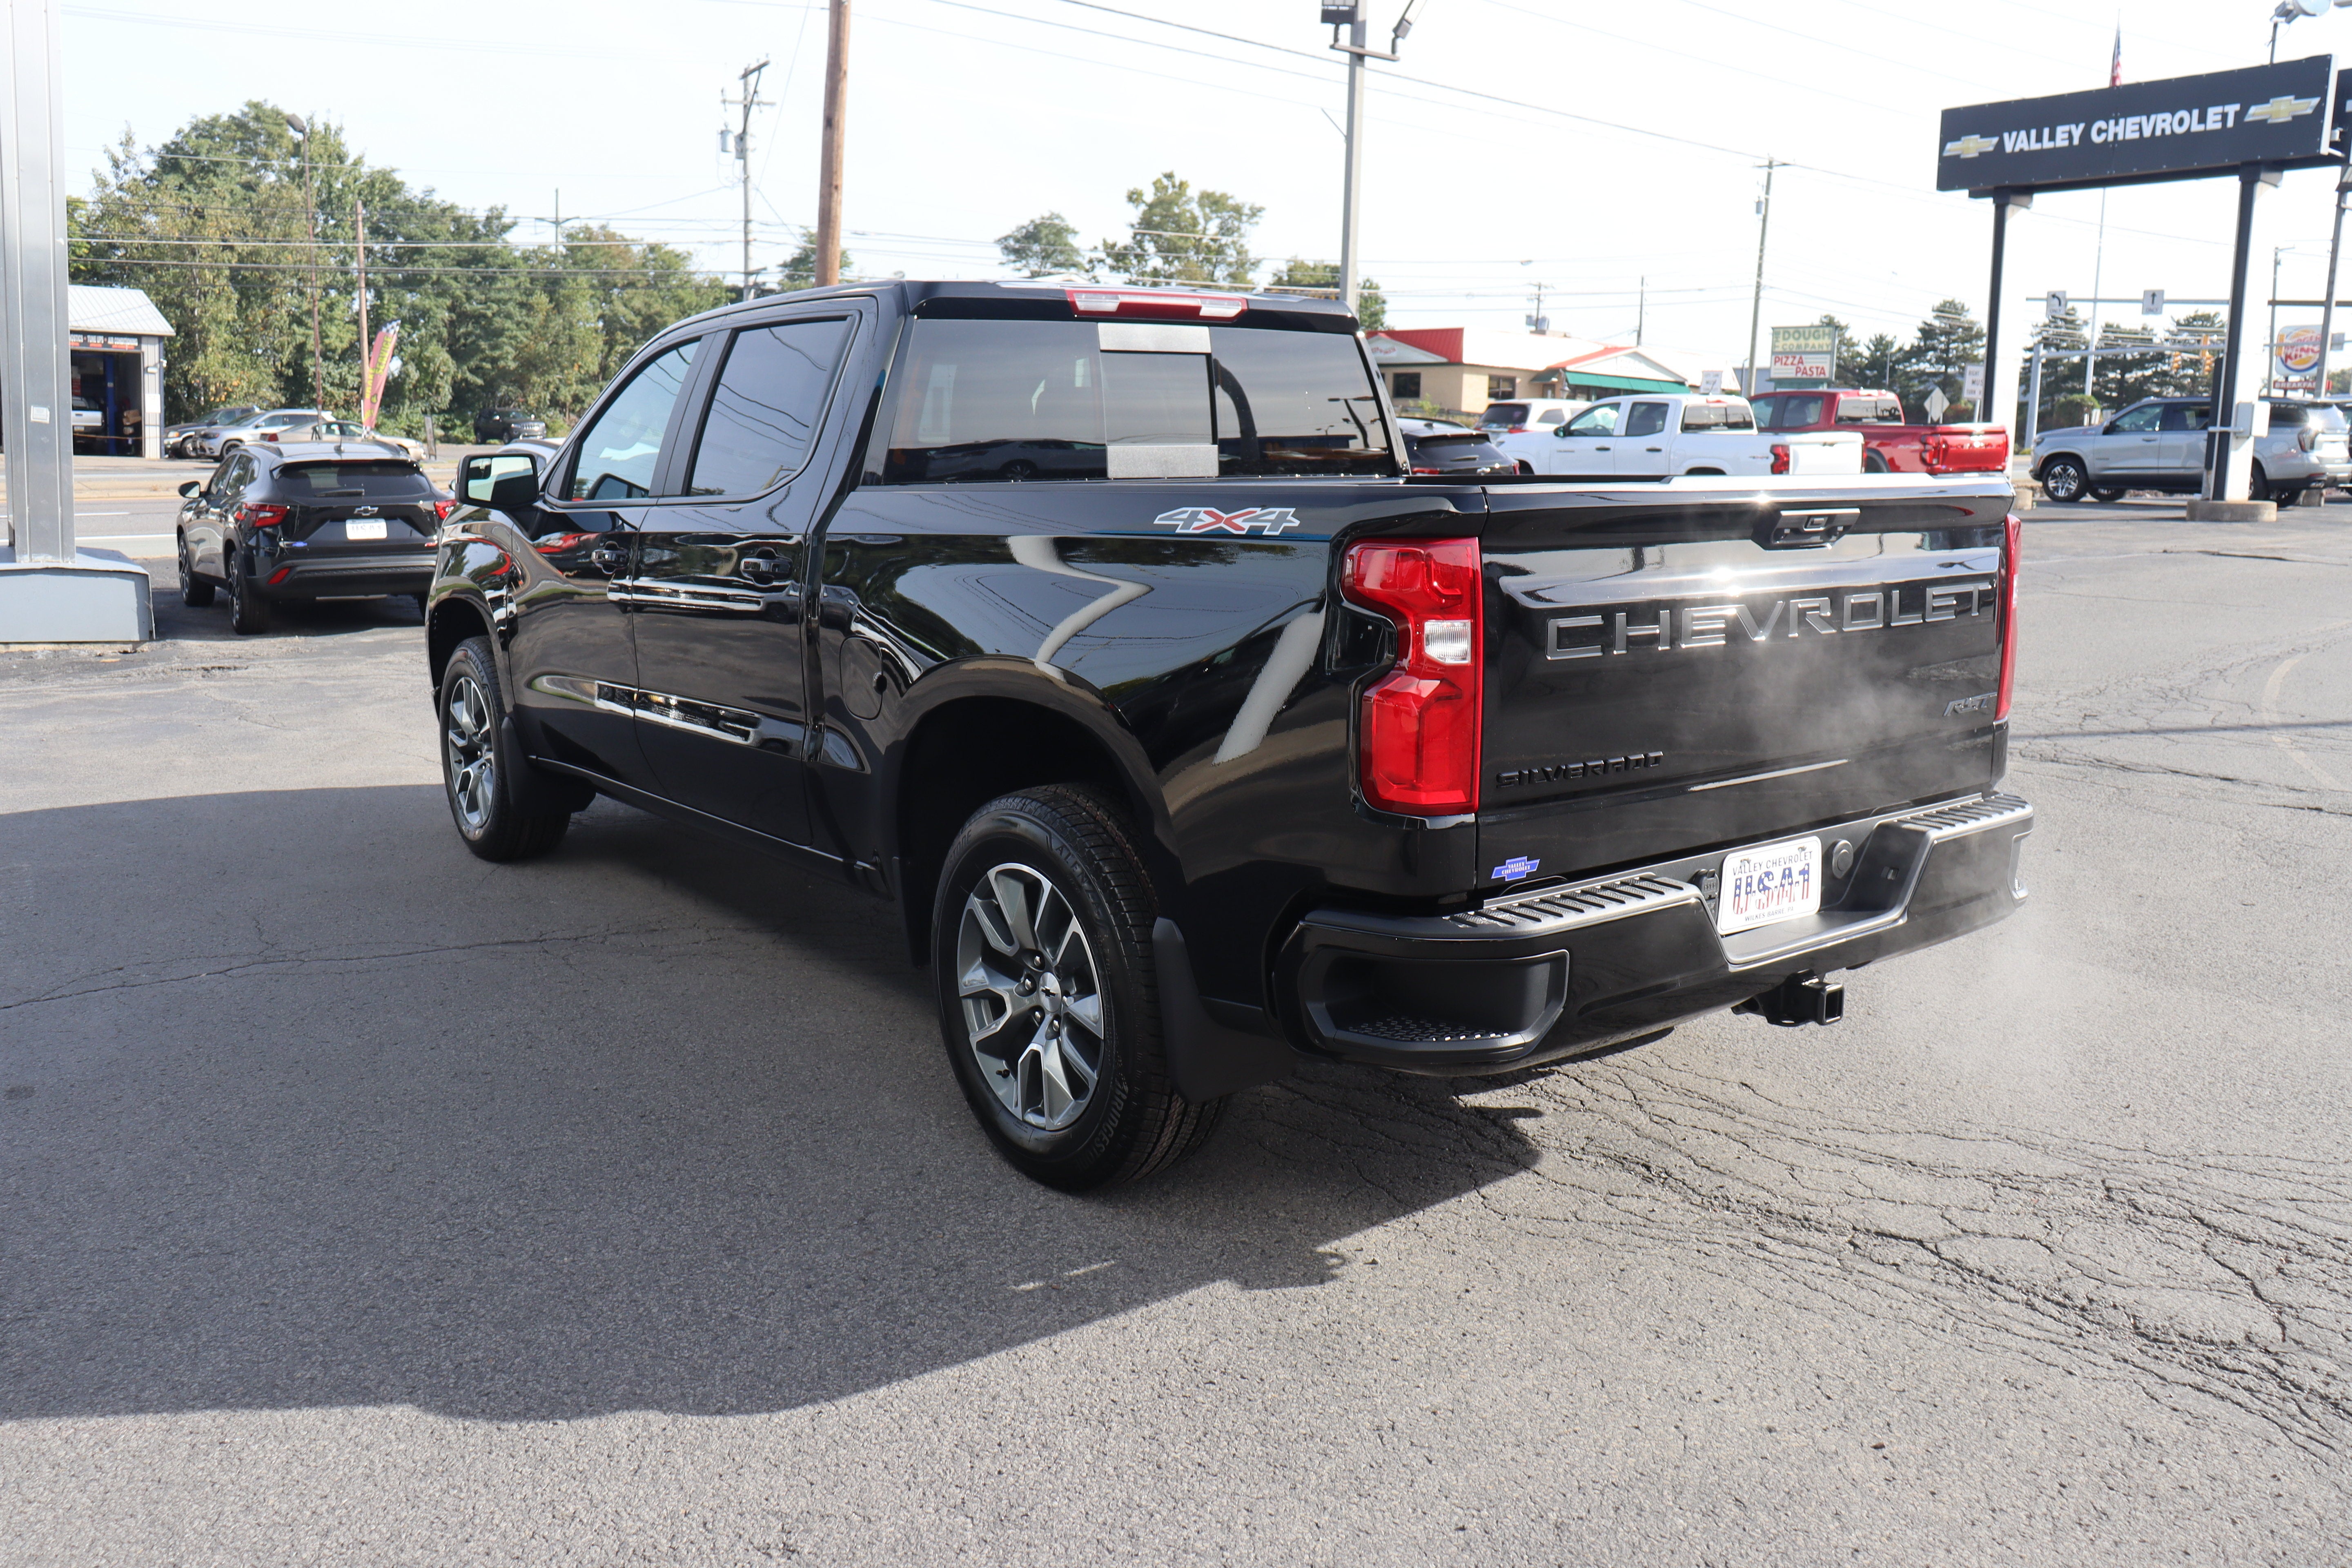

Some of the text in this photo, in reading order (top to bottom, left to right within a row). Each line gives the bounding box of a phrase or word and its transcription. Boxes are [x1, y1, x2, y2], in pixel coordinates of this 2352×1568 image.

[2003, 103, 2241, 153] VALLEY CHEVROLET
[1782, 330, 1831, 341] DOUGH
[1782, 343, 1831, 351] COMPANY
[375, 335, 392, 375] SERVICE
[1774, 355, 1804, 366] PIZZA
[1795, 366, 1826, 377] PASTA
[1546, 581, 1993, 660] CHEVROLET
[1496, 751, 1663, 788] SILVERADO
[1733, 851, 1813, 876] VALLEY CHEVROLET
[1501, 865, 1530, 875] CHEVROLET
[1745, 912, 1765, 922] WILKES
